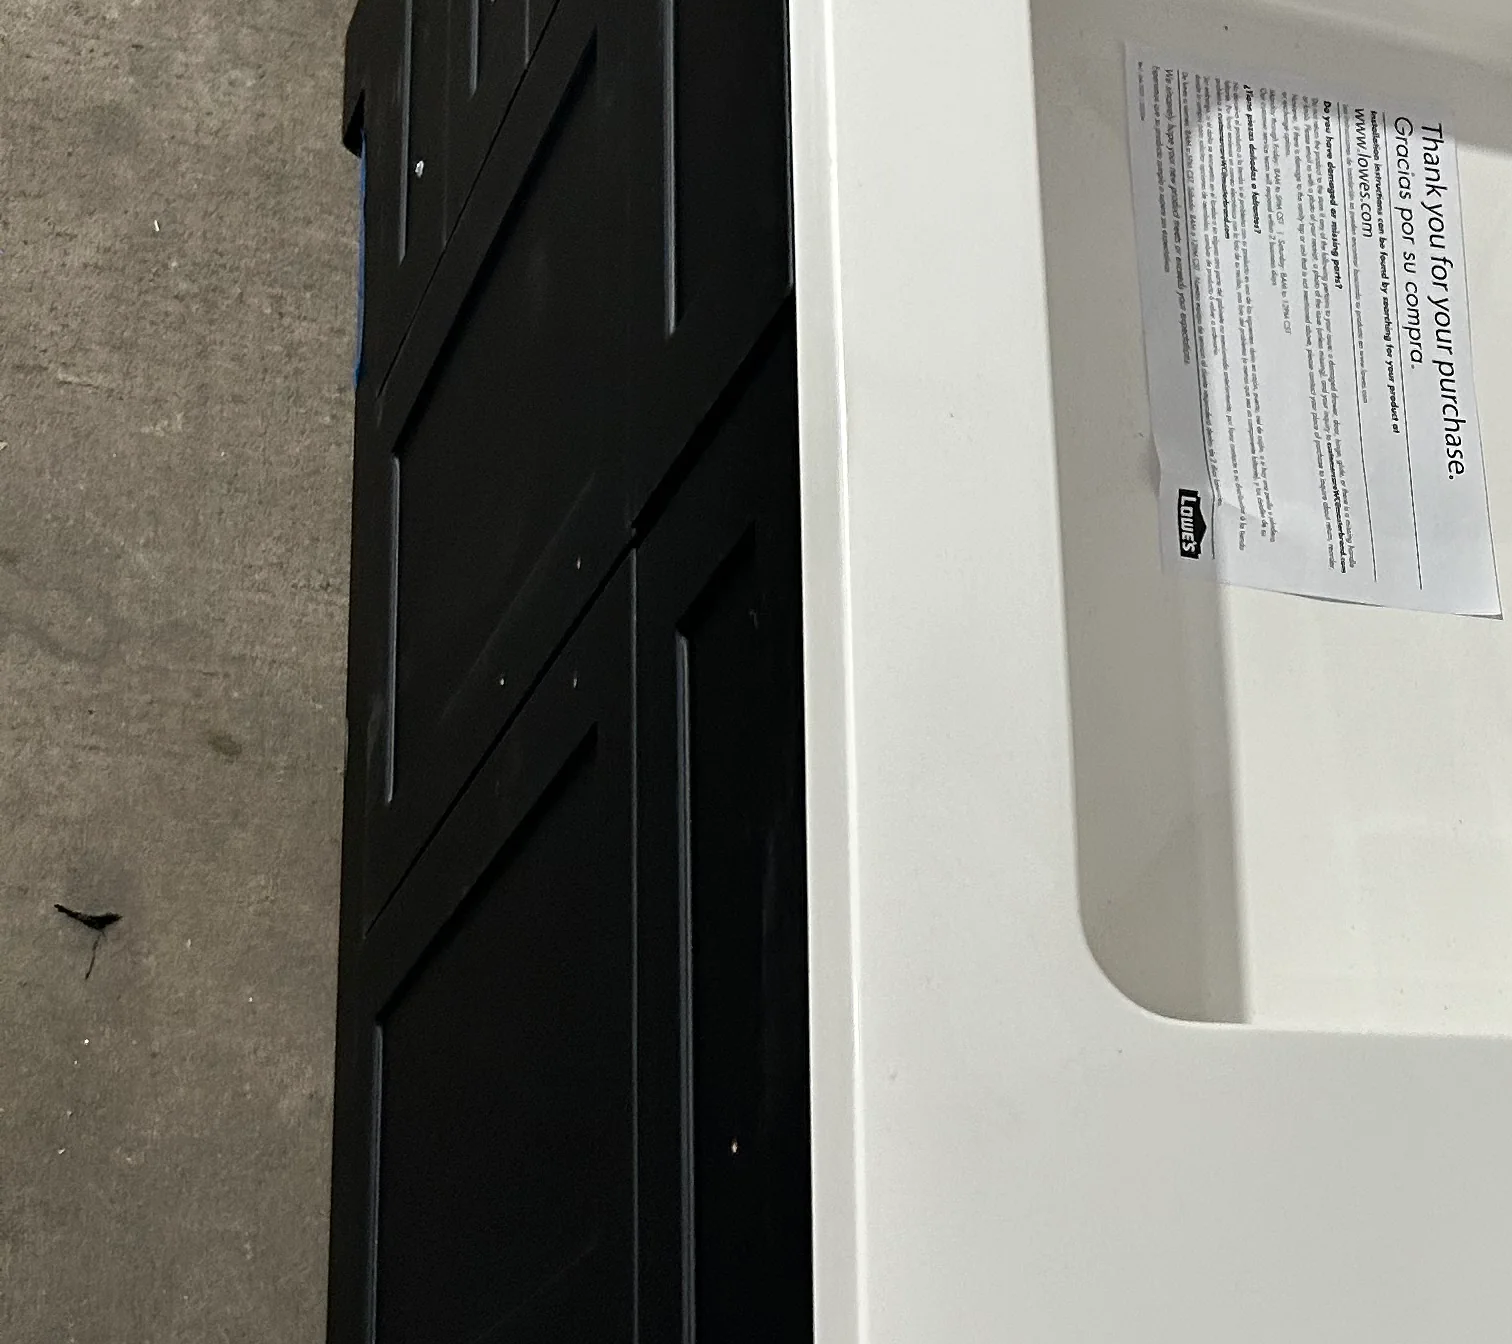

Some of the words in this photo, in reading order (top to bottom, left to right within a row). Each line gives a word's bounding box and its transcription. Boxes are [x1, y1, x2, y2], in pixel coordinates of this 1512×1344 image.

[1321, 115, 1331, 133] you
[1323, 100, 1332, 115] Do
[1325, 136, 1334, 159] have
[1371, 111, 1380, 160] Installation
[1355, 109, 1372, 237] www.lowes.com
[1394, 117, 1414, 199] Gracias
[1422, 124, 1447, 196] Thank
[1327, 162, 1338, 206] damaged
[1374, 163, 1382, 215] instructions
[1330, 207, 1336, 219] or
[1394, 206, 1414, 244] por
[1421, 201, 1445, 248] you
[1330, 221, 1340, 256] missing
[1379, 237, 1387, 249] be
[1331, 258, 1342, 289] parts?
[1380, 251, 1389, 279] found
[1403, 251, 1416, 273] su
[1431, 256, 1453, 291] for
[1380, 281, 1390, 294] by
[1383, 297, 1392, 341] searching
[1403, 282, 1422, 368] compra.
[1427, 296, 1452, 354] your
[1386, 344, 1394, 357] for
[1385, 360, 1394, 382] your
[1387, 384, 1399, 421] product
[1433, 360, 1464, 478] purchase.
[1392, 423, 1400, 433] at
[1179, 494, 1198, 553] LOWE'S
